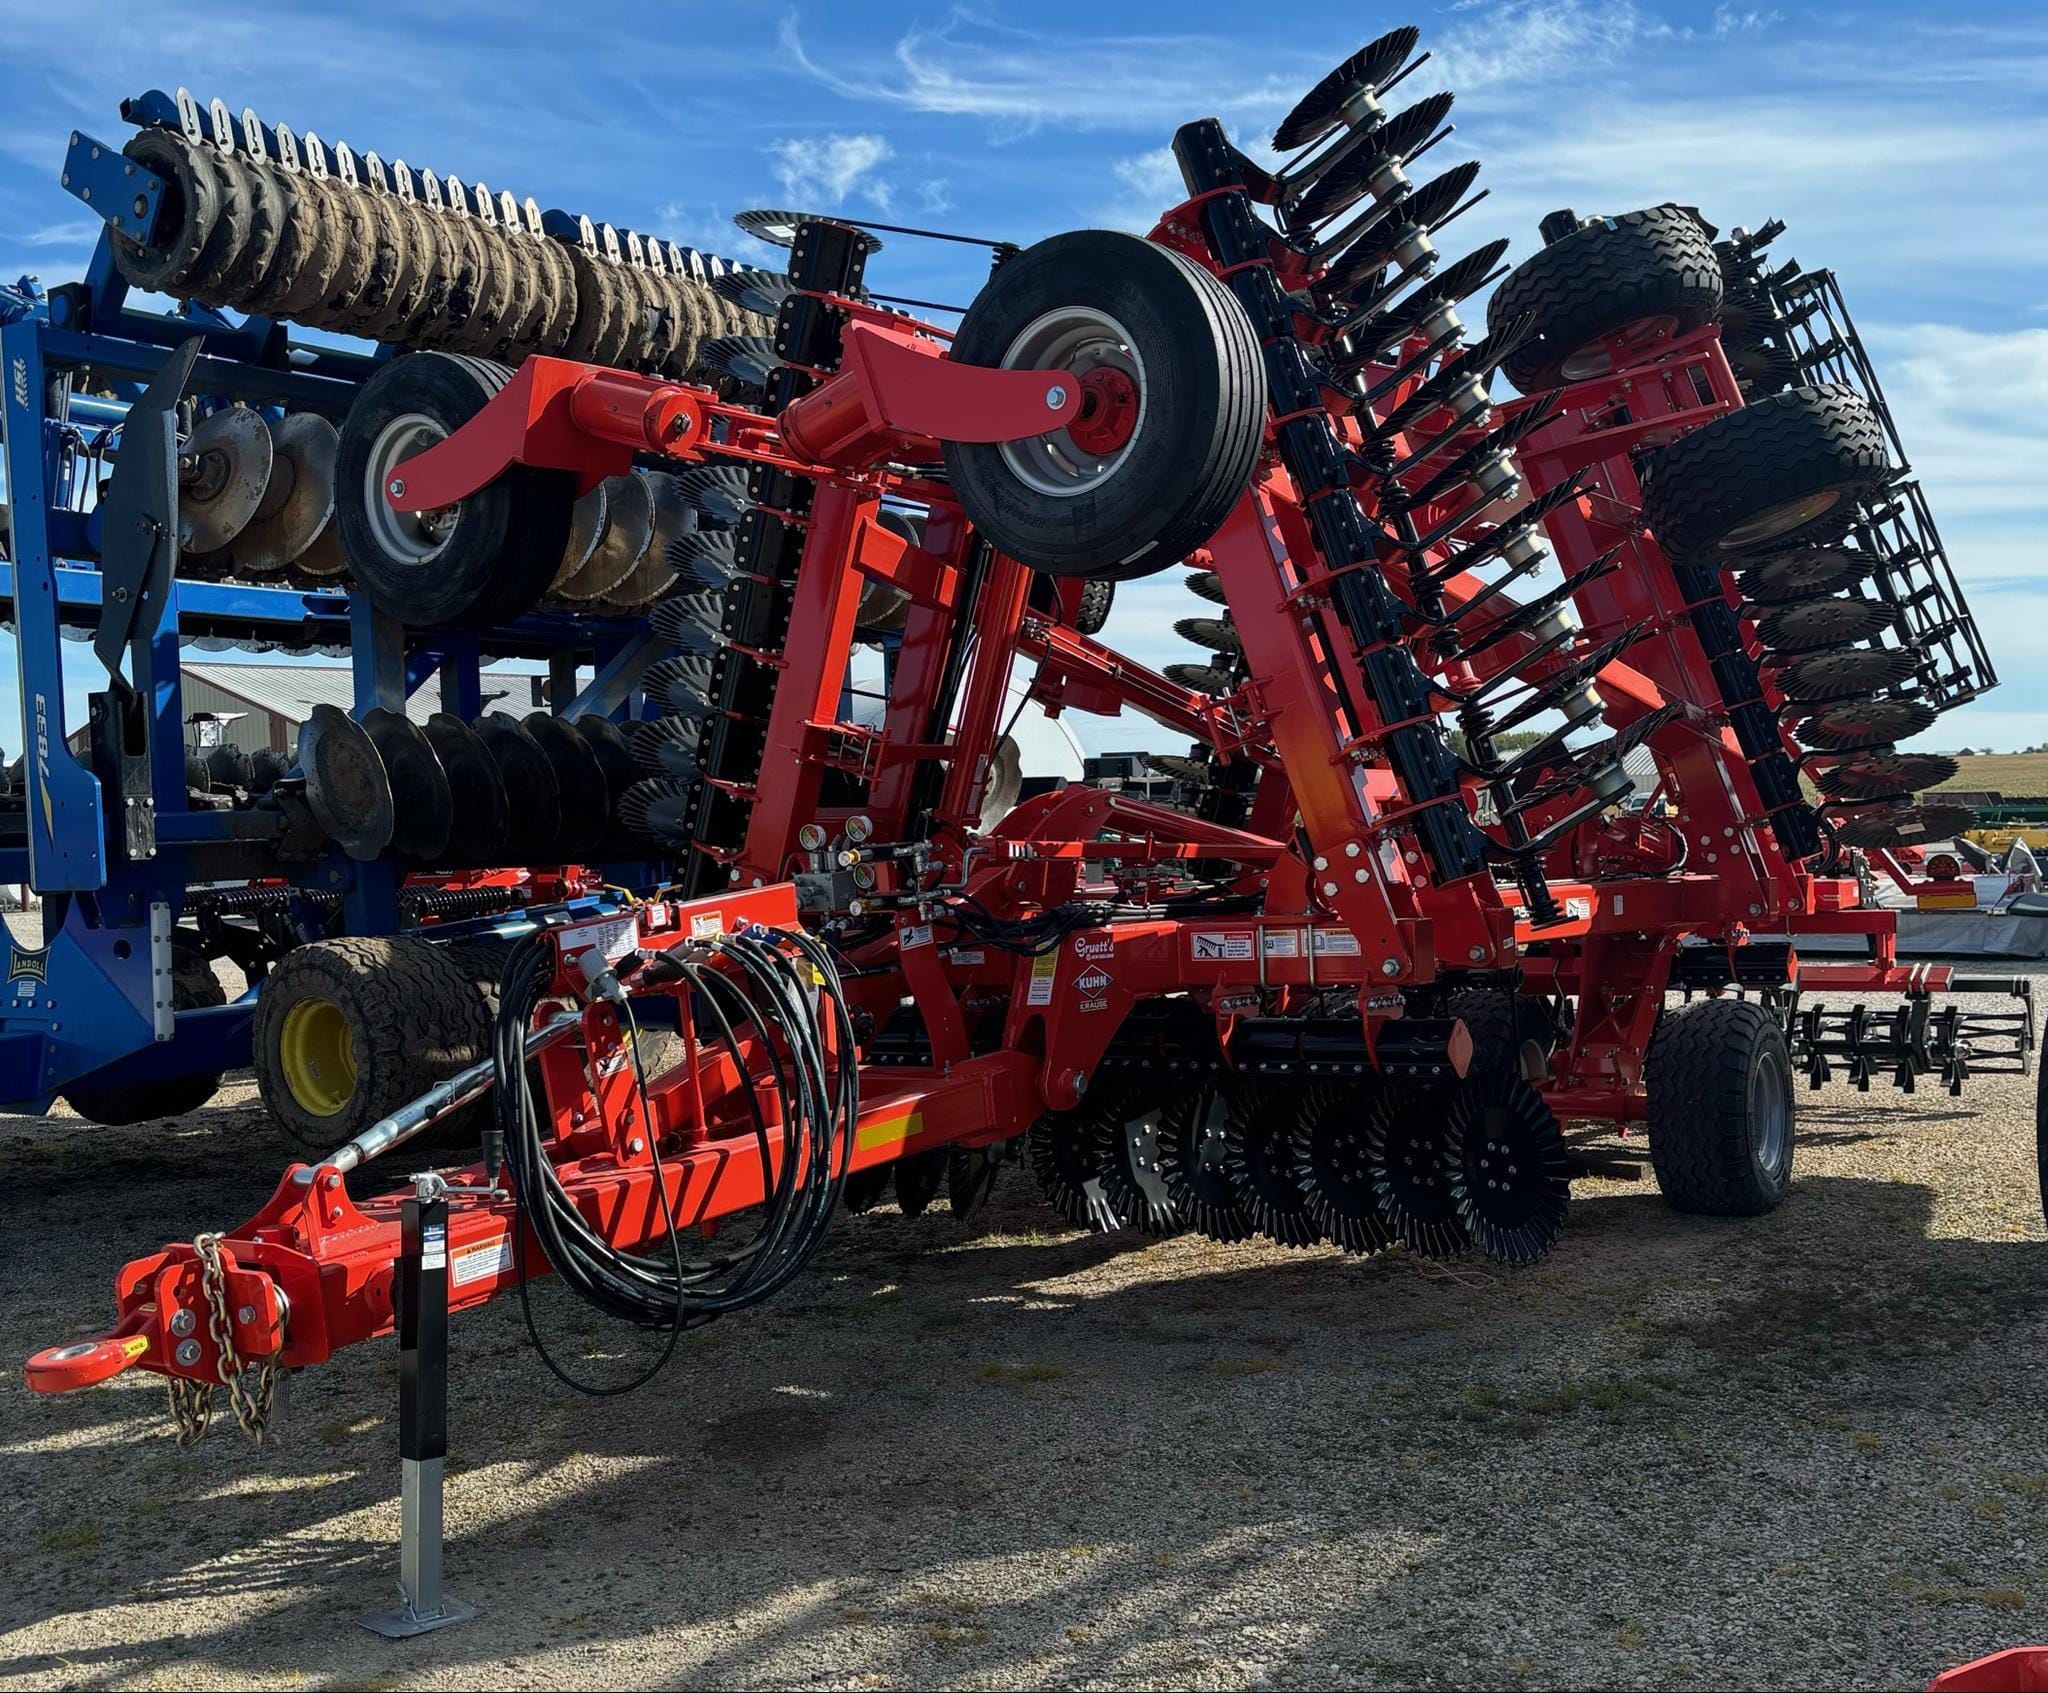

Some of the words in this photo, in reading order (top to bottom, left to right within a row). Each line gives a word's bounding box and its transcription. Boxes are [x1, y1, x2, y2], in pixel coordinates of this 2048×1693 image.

[36, 693, 50, 778] 7833
[12, 953, 44, 977] LANDOLL
[1079, 975, 1107, 989] KUHN
[1080, 1001, 1107, 1010] KRAUSE
